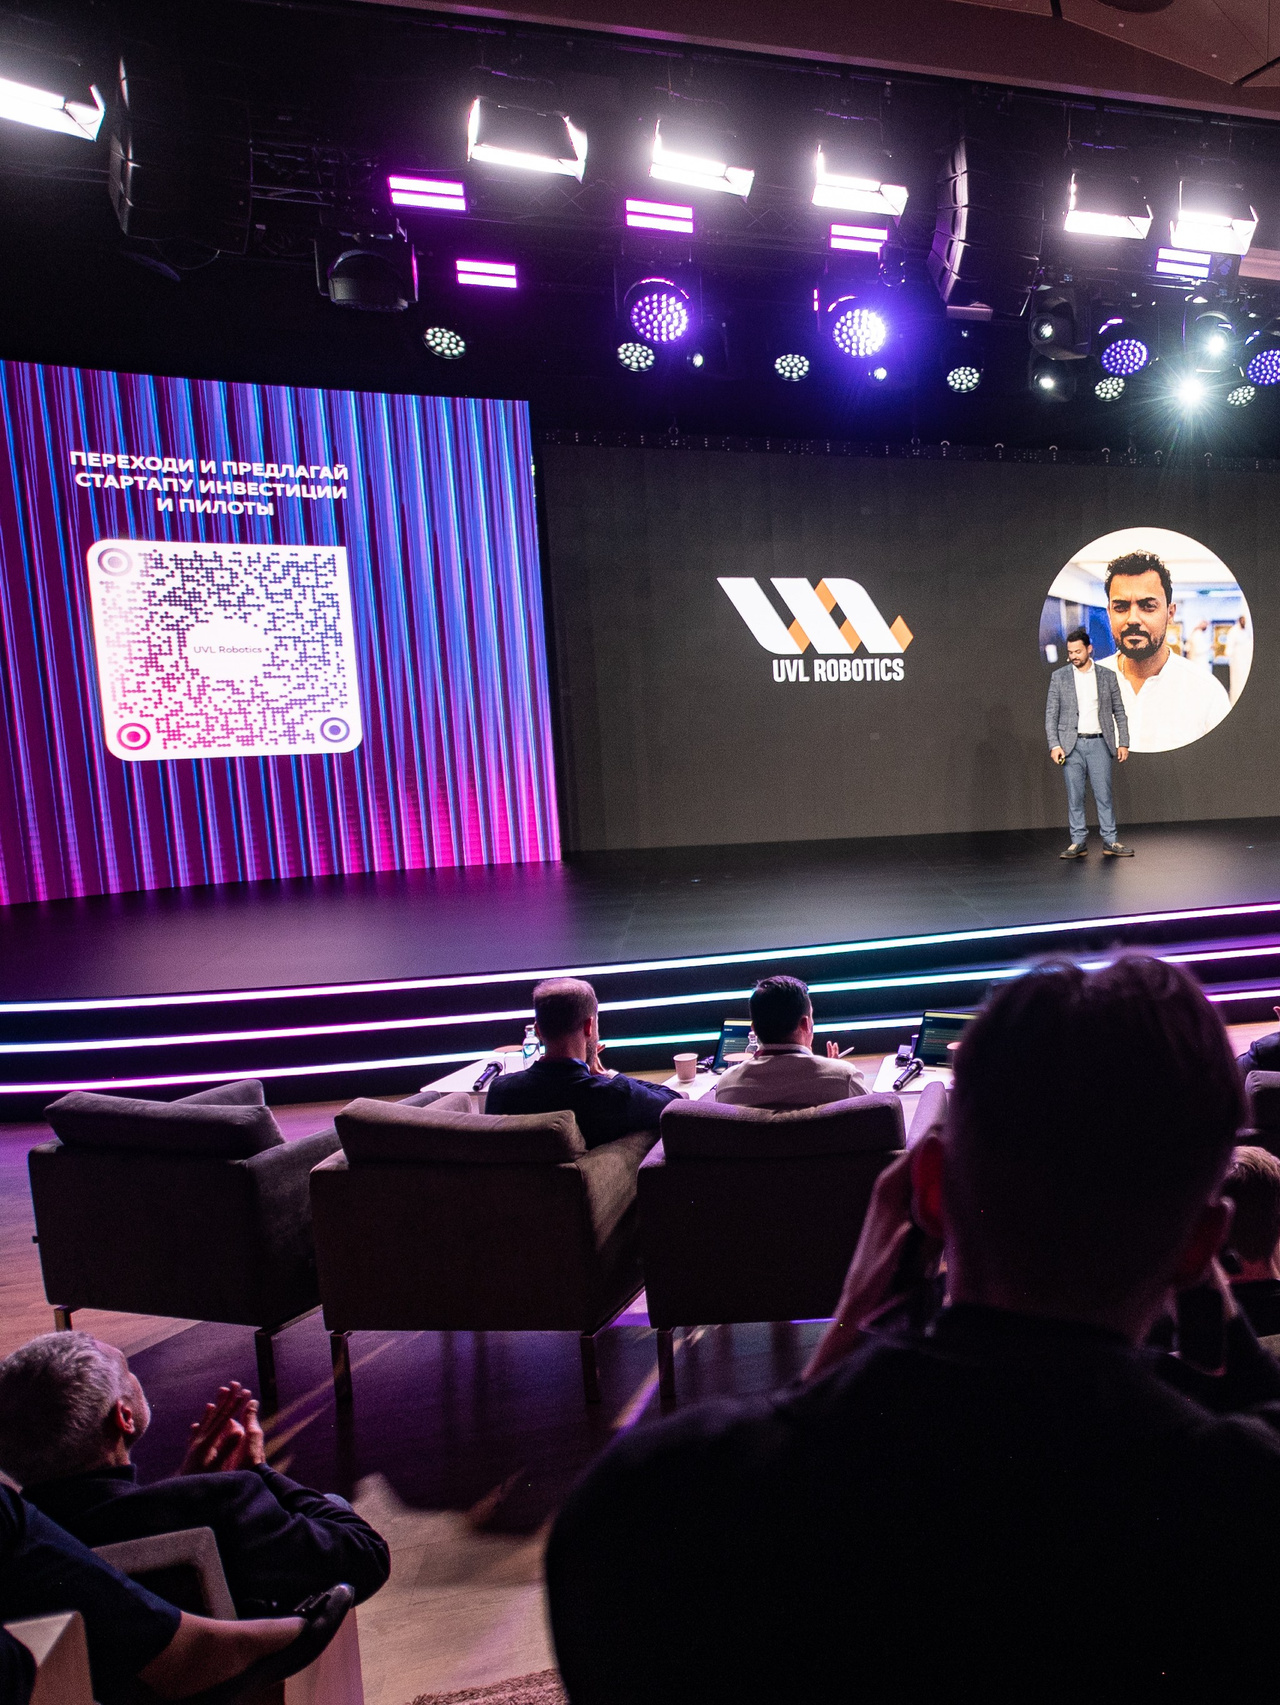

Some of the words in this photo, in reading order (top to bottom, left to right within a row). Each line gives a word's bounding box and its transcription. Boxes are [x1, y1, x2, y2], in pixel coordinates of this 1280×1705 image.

[69, 451, 194, 473] ПЕРЕХОДИ
[200, 459, 217, 474] И
[222, 461, 349, 481] ПРЕДЛАГАЙ
[75, 473, 193, 493] СТАРТАПУ
[199, 480, 348, 500] ИНВЕСТИЦИИ
[157, 498, 173, 512] И
[180, 500, 275, 516] ПИЛОТЫ
[193, 646, 216, 654] UVL
[218, 646, 262, 654] Robotics
[772, 658, 810, 683] UVL
[814, 658, 905, 682] ROBOTICS
